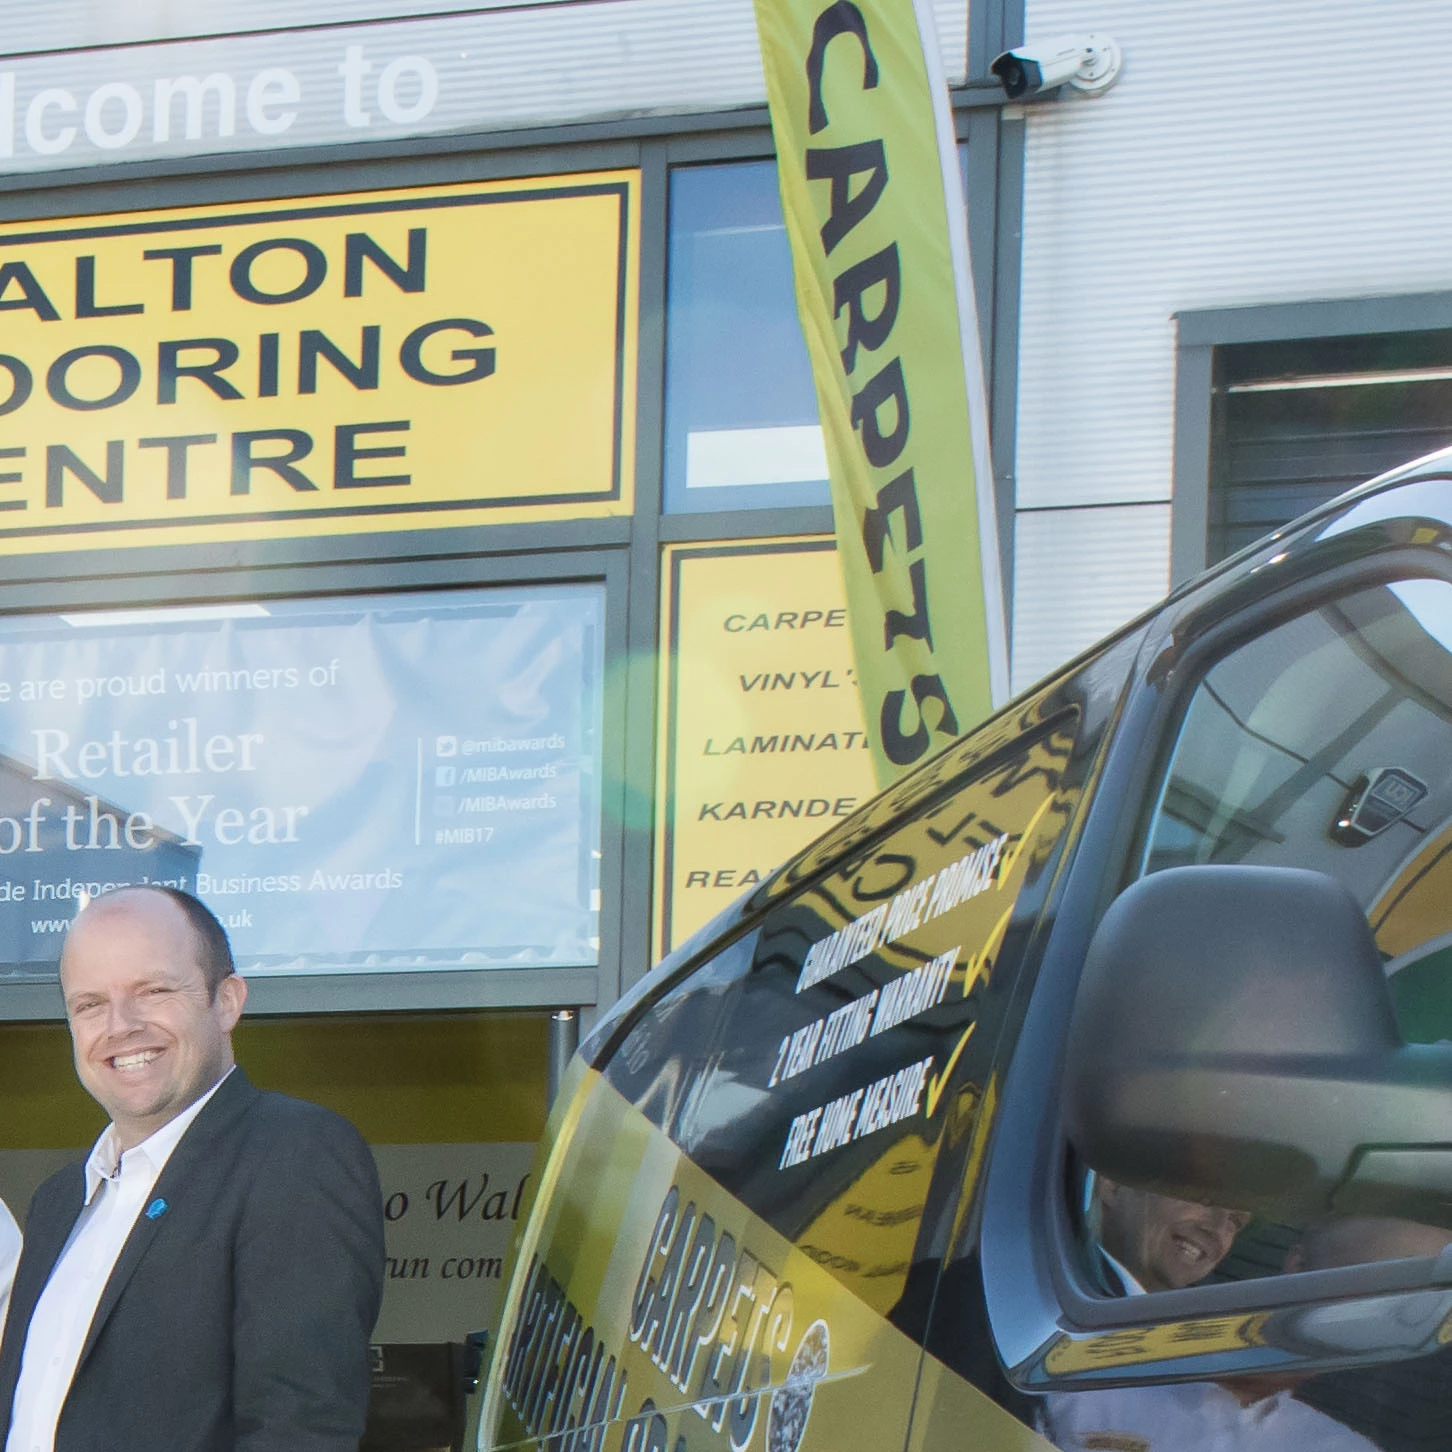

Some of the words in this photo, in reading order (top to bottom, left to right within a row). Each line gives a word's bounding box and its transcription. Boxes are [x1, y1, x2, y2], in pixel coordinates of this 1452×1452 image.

[338, 45, 439, 128] to
[806, 1, 960, 766] CARPETS
[723, 609, 846, 632] CARPE
[18, 680, 67, 699] are
[76, 672, 166, 704] proud
[174, 667, 298, 690] winners
[308, 659, 340, 687] of
[739, 669, 857, 691] VINYL'
[33, 718, 264, 781] Retailer
[462, 734, 565, 755] @mibawards
[703, 732, 867, 755] LAMINAT
[62, 798, 155, 850] the
[176, 795, 309, 848] Year
[698, 799, 856, 820] KARNDE
[196, 873, 301, 896] Business
[308, 868, 403, 891] Awards
[685, 869, 774, 887] REA
[779, 1107, 823, 1170] FREE
[812, 1088, 864, 1157] HOME
[853, 1056, 934, 1140] MEASURE
[384, 1191, 409, 1222] o
[425, 1173, 531, 1221] Wal
[441, 1256, 502, 1280] com
